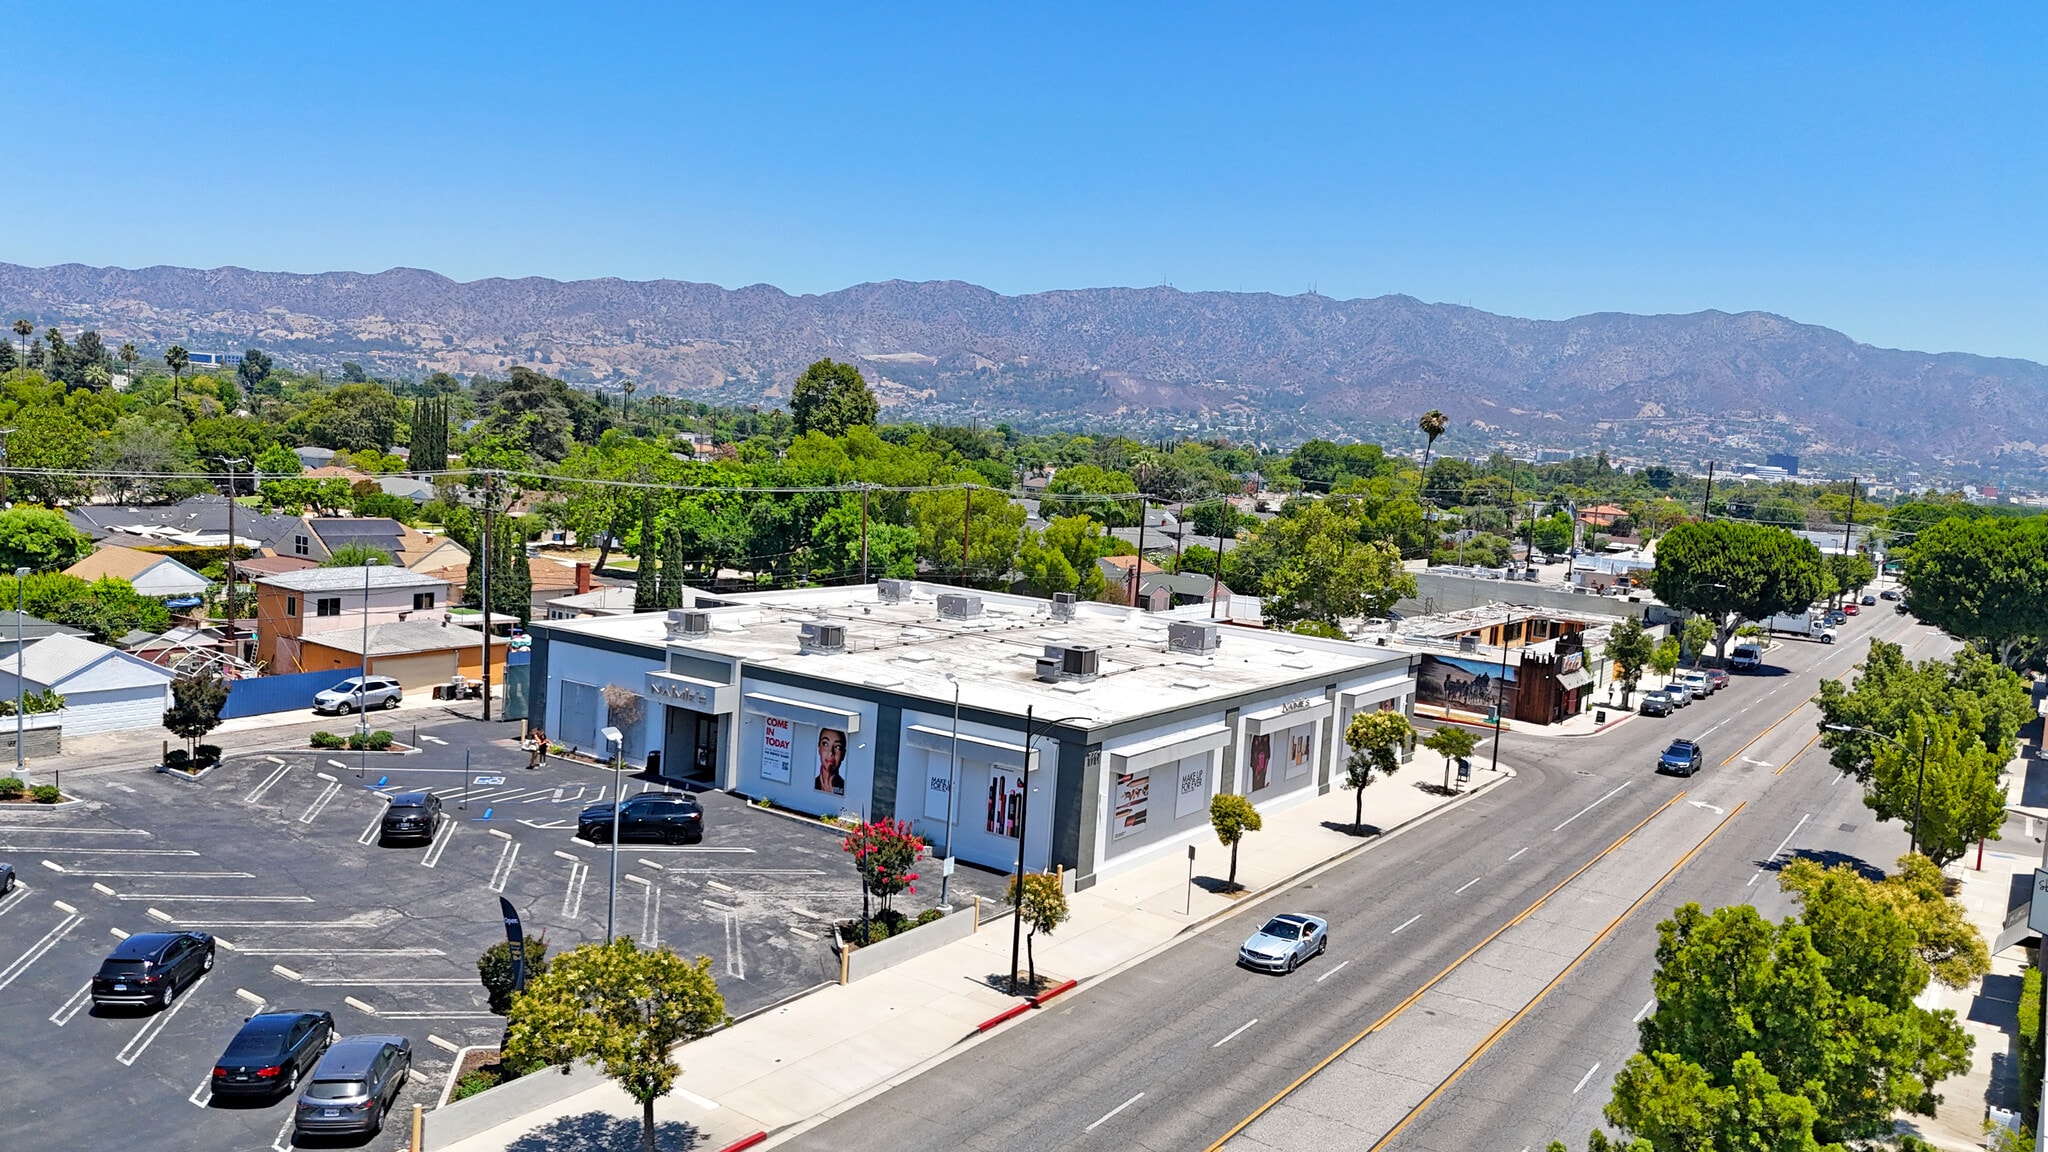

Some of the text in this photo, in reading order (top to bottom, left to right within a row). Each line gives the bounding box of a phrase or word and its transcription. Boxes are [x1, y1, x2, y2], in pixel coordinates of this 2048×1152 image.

[766, 717, 789, 730] COME
[766, 726, 775, 737] IN
[765, 736, 790, 750] TODAY
[1182, 771, 1196, 783] MAKE
[504, 917, 519, 926] Open
